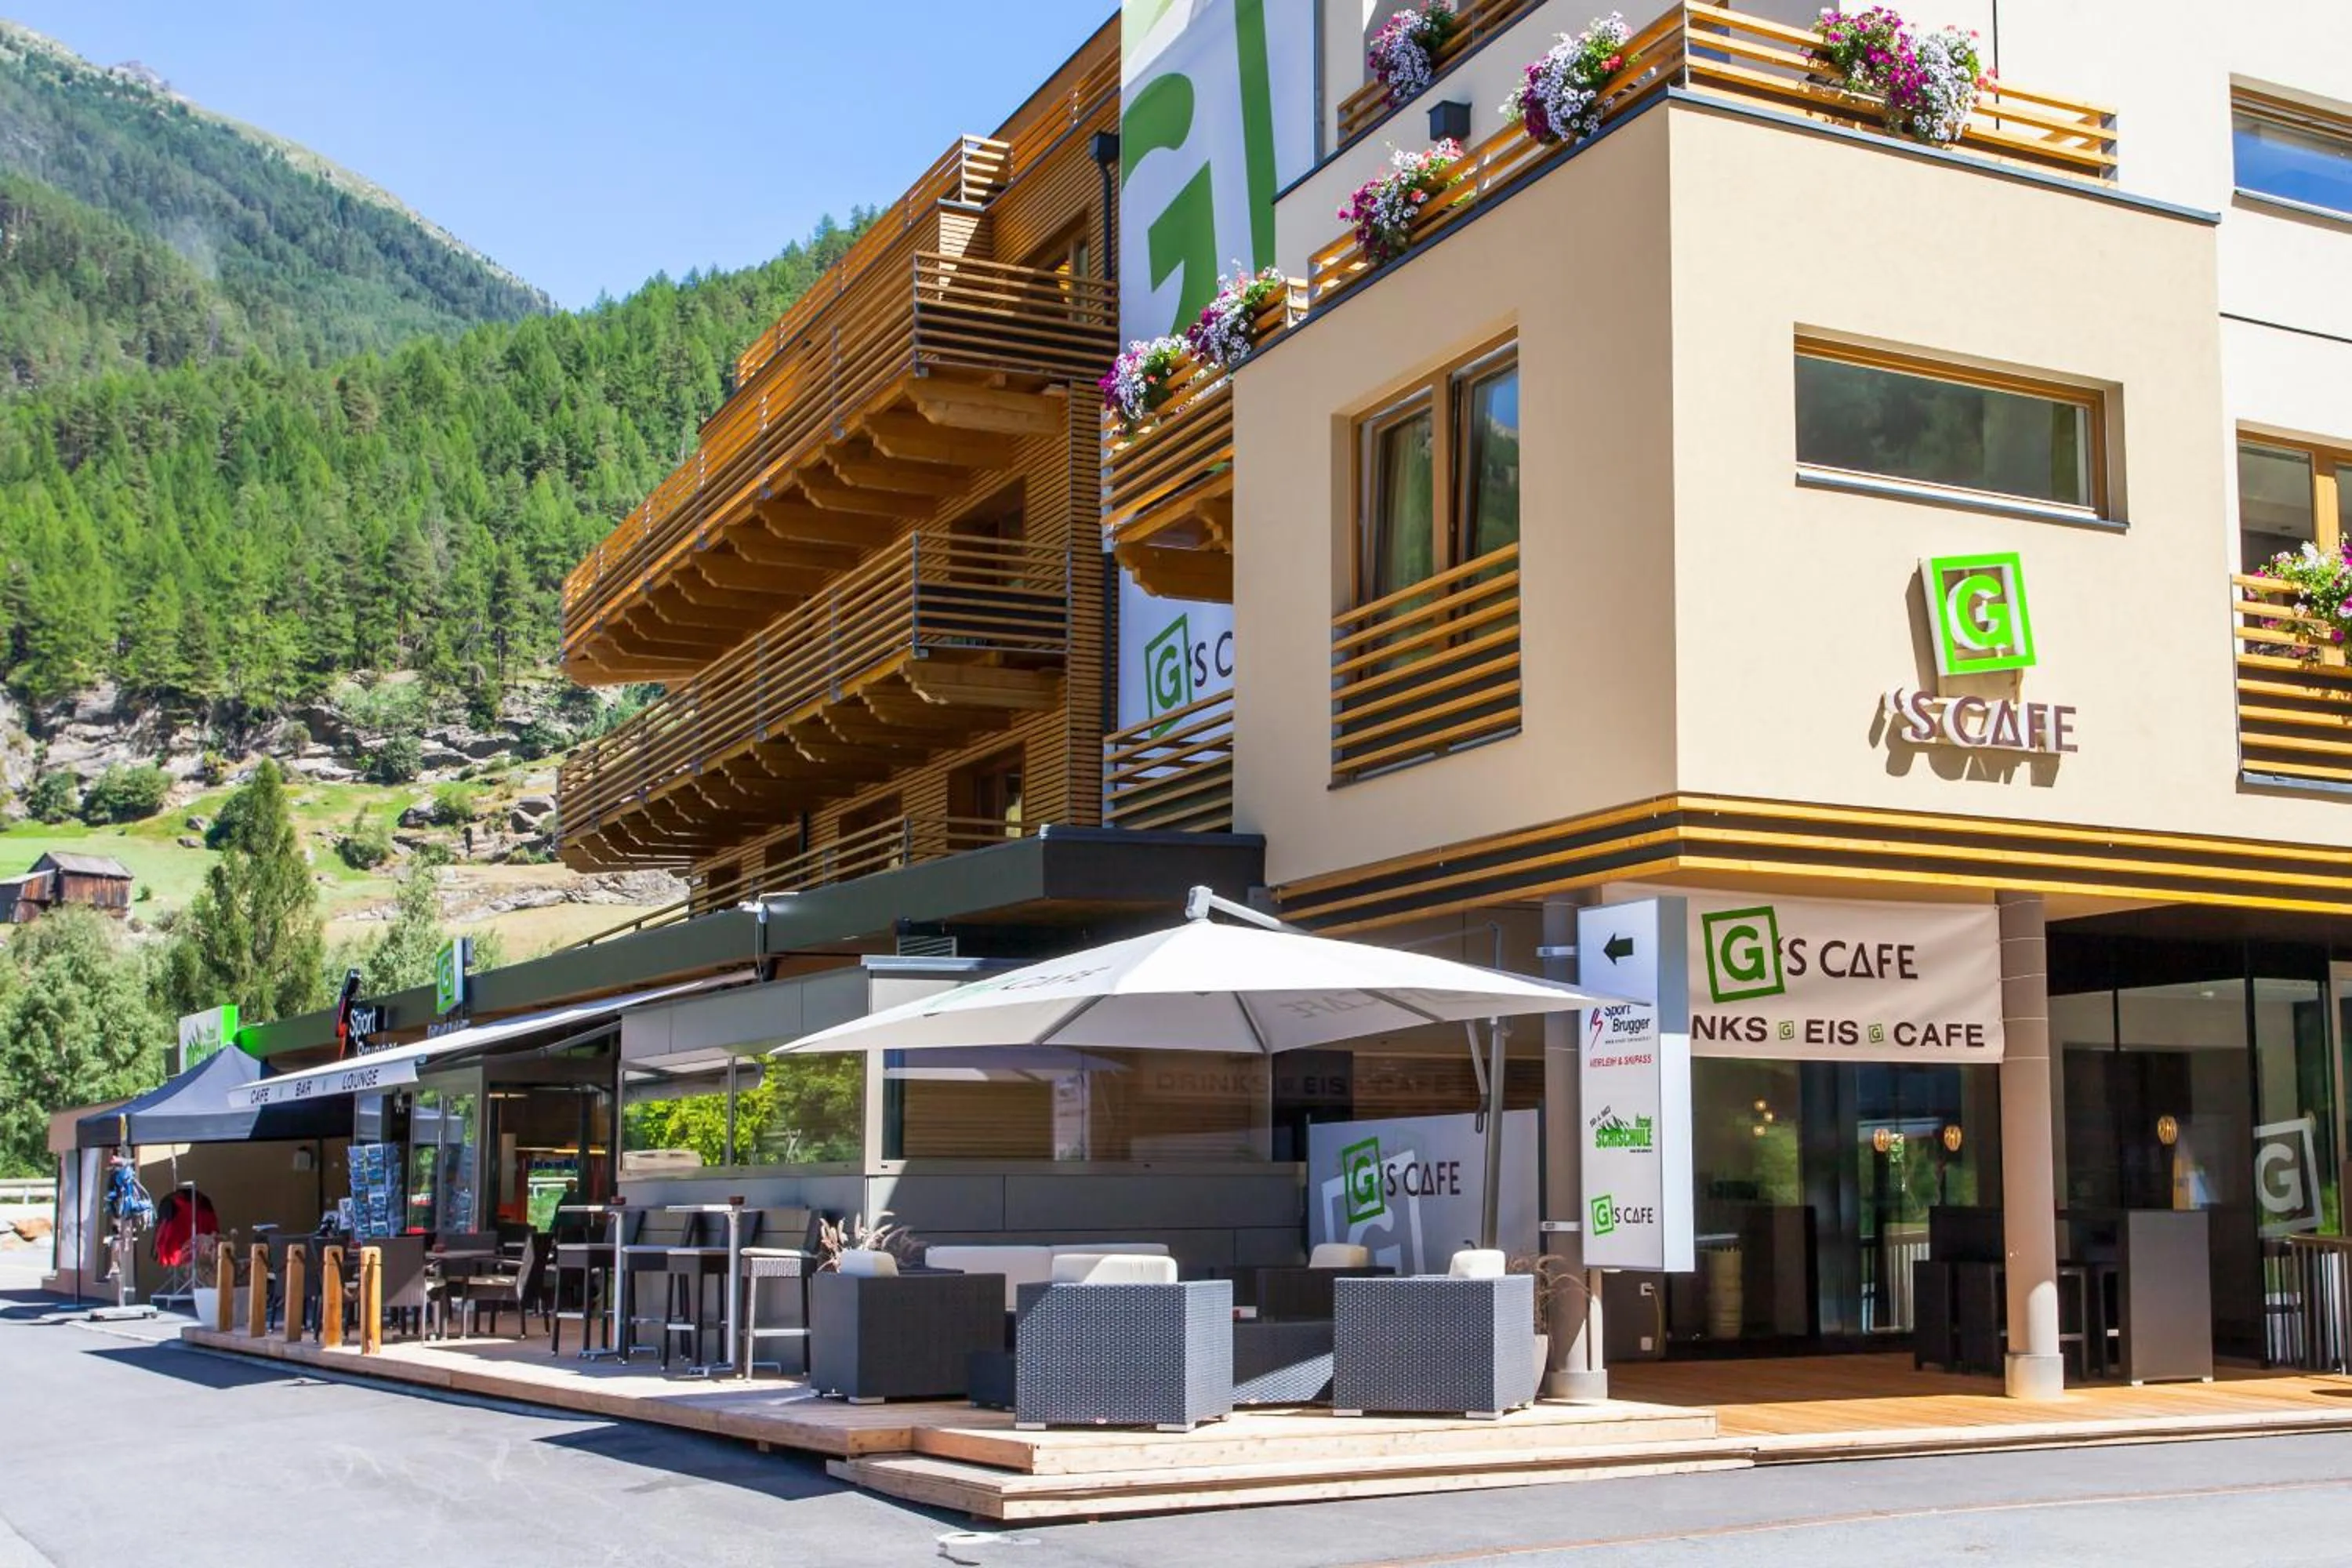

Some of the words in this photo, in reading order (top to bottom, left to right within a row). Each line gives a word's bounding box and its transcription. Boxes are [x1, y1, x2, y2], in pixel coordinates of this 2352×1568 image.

[1947, 575, 2013, 649] G
[1947, 696, 2078, 753] CAFE
[1819, 940, 1918, 980] CAFE
[350, 1007, 376, 1044] Sport
[1612, 1018, 1650, 1035] Brugger
[1806, 1019, 1859, 1045] EIS
[1893, 1022, 1986, 1047] CAFE
[296, 1080, 313, 1097] BAR
[342, 1069, 380, 1090] LOUNGE
[1303, 1075, 1348, 1095] EIS
[1403, 1161, 1461, 1196] CAFE
[2254, 1143, 2303, 1213] G
[1624, 1207, 1653, 1224] CAFE
